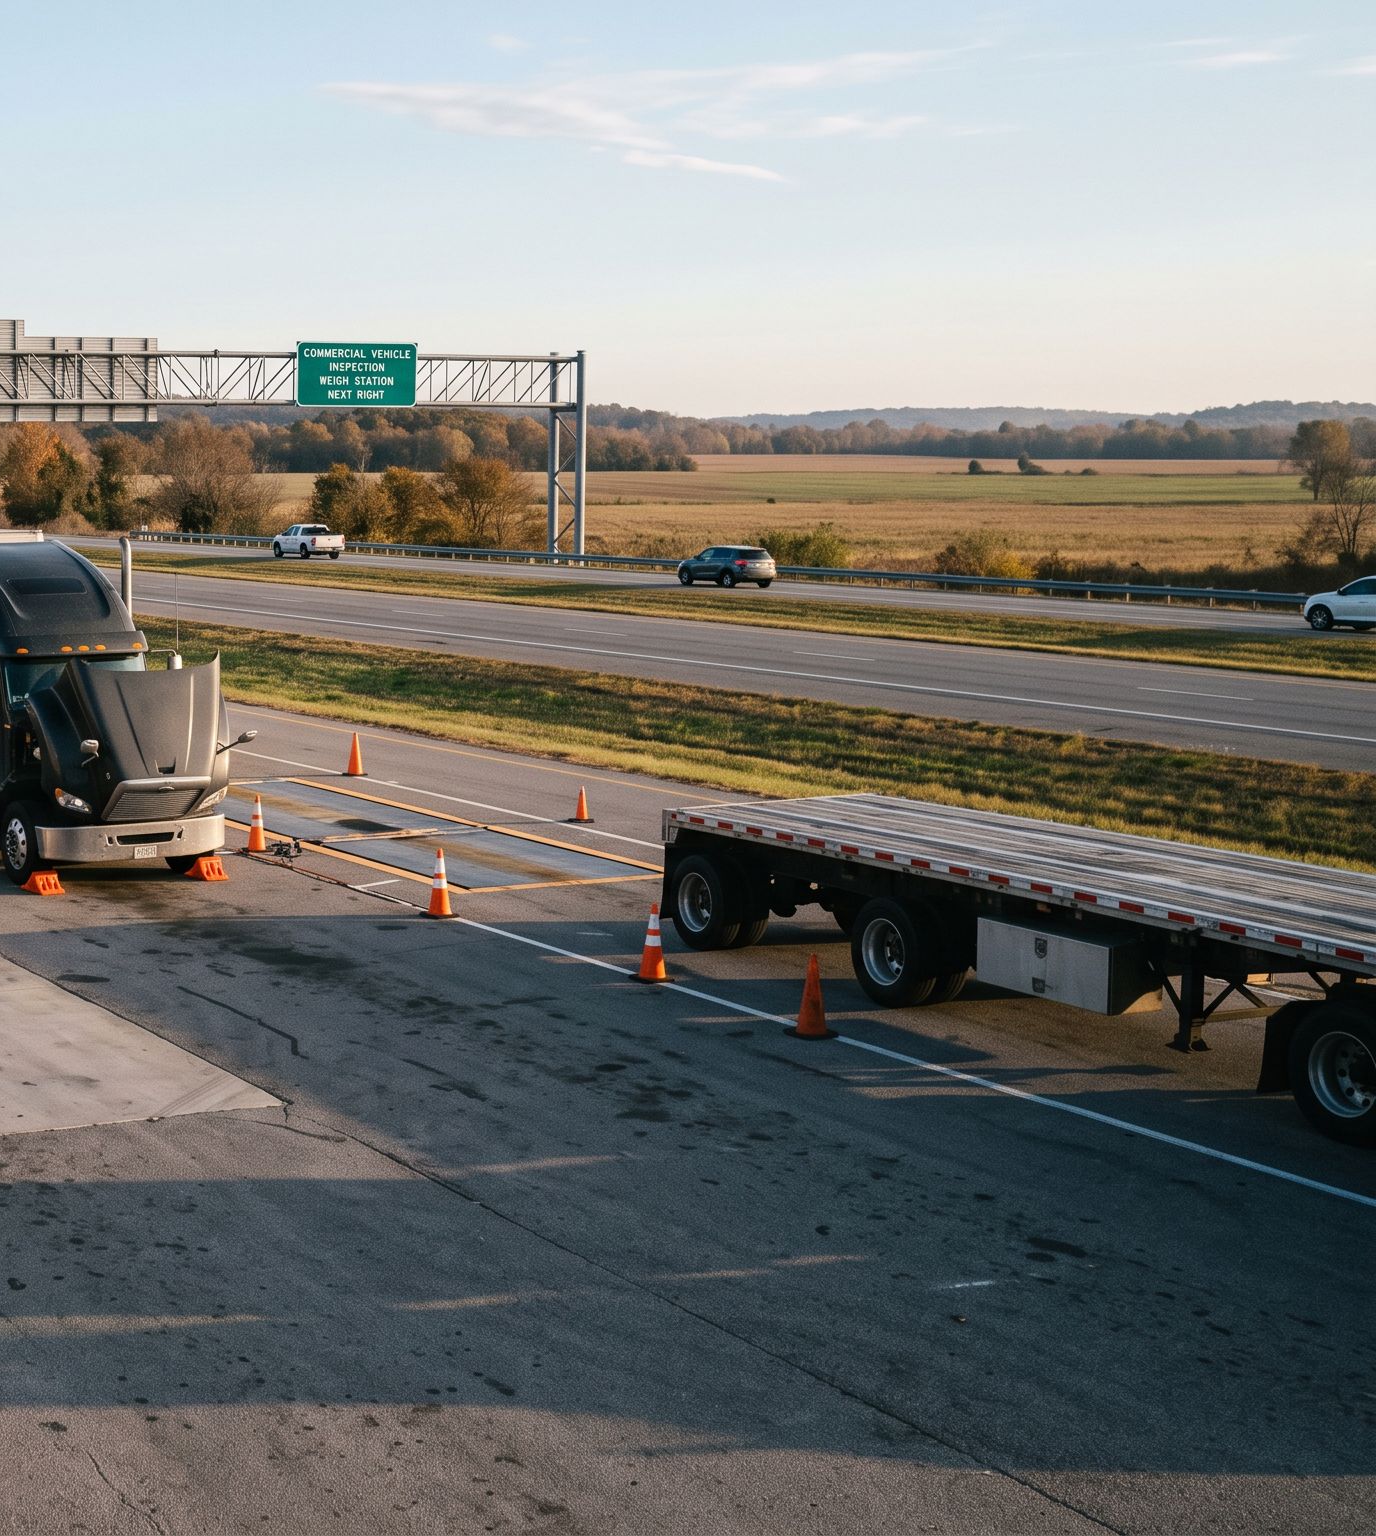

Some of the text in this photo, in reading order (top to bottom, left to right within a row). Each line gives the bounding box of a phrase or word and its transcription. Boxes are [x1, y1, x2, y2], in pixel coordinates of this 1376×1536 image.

[304, 349, 411, 359] COMMERCIAL VEHICLE
[329, 362, 385, 372] INSPECTION
[319, 376, 394, 386] WEIGH STATION
[328, 390, 385, 400] NEXT RIGHT
